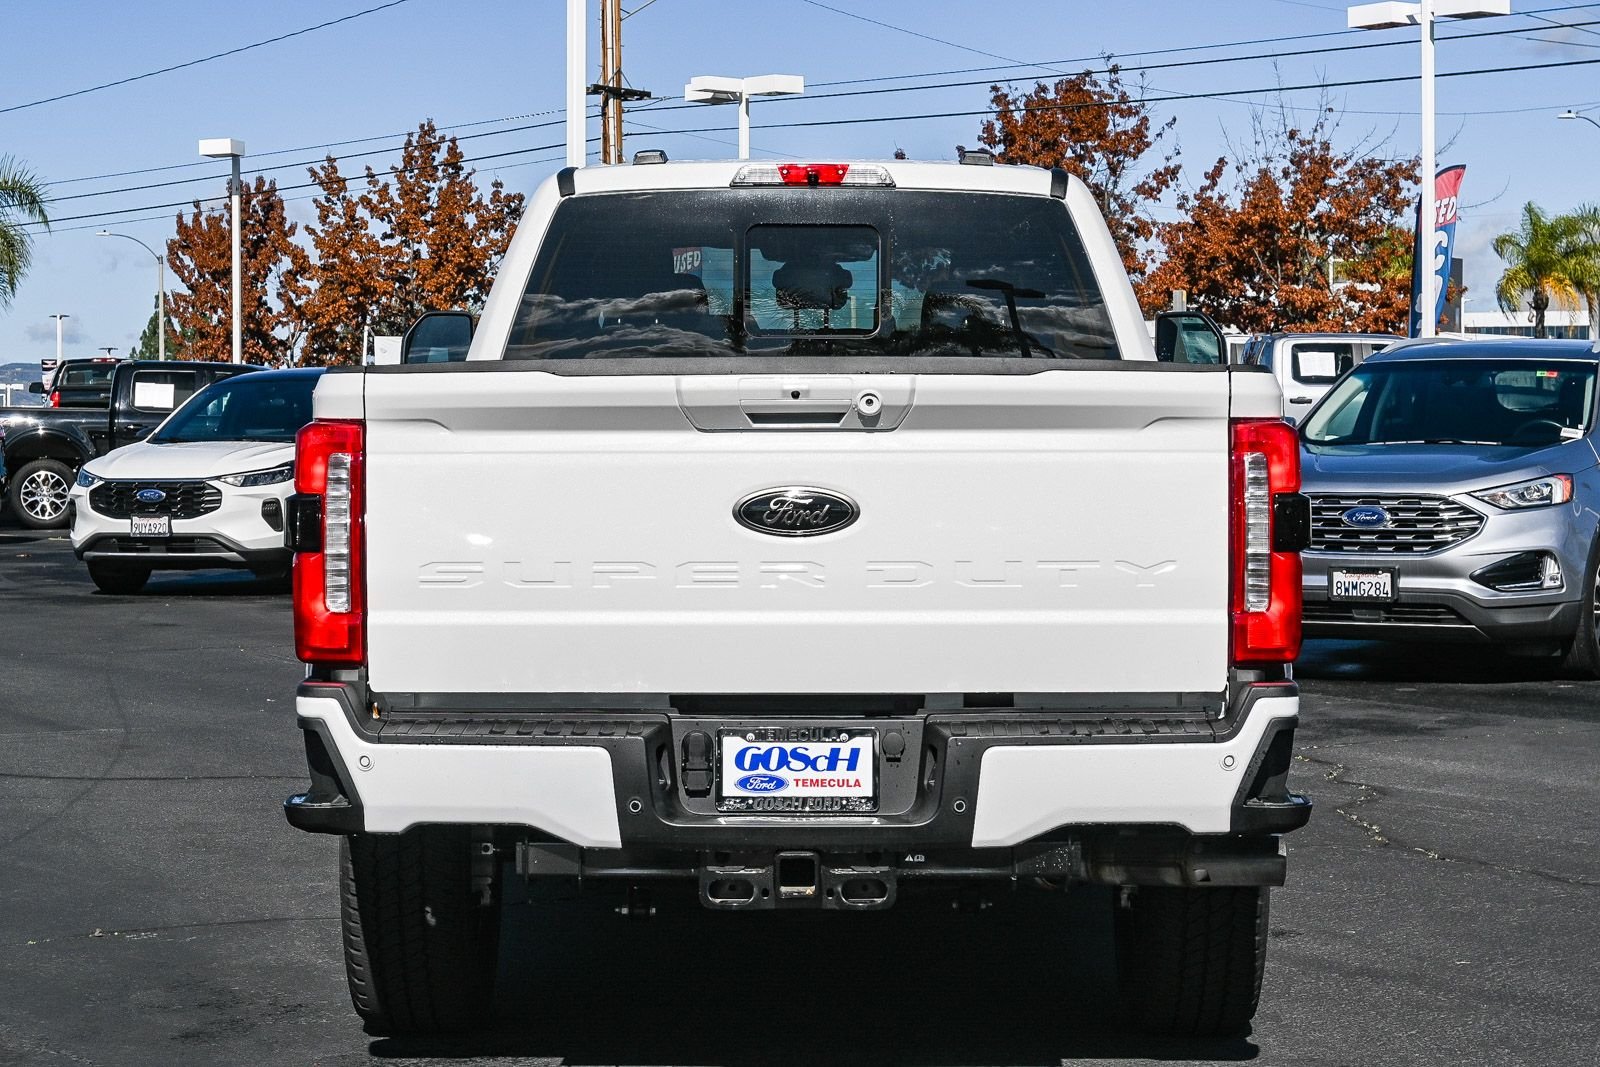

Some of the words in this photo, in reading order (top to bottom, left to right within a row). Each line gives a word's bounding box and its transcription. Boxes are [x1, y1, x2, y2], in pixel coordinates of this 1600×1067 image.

[673, 251, 701, 273] USED
[762, 496, 831, 525] Ford
[419, 560, 825, 589] SUPER
[866, 559, 1178, 589] DUTY
[1335, 580, 1389, 597] 8WMG284
[746, 777, 777, 790] Ford
[793, 778, 861, 788] TEMECULA
